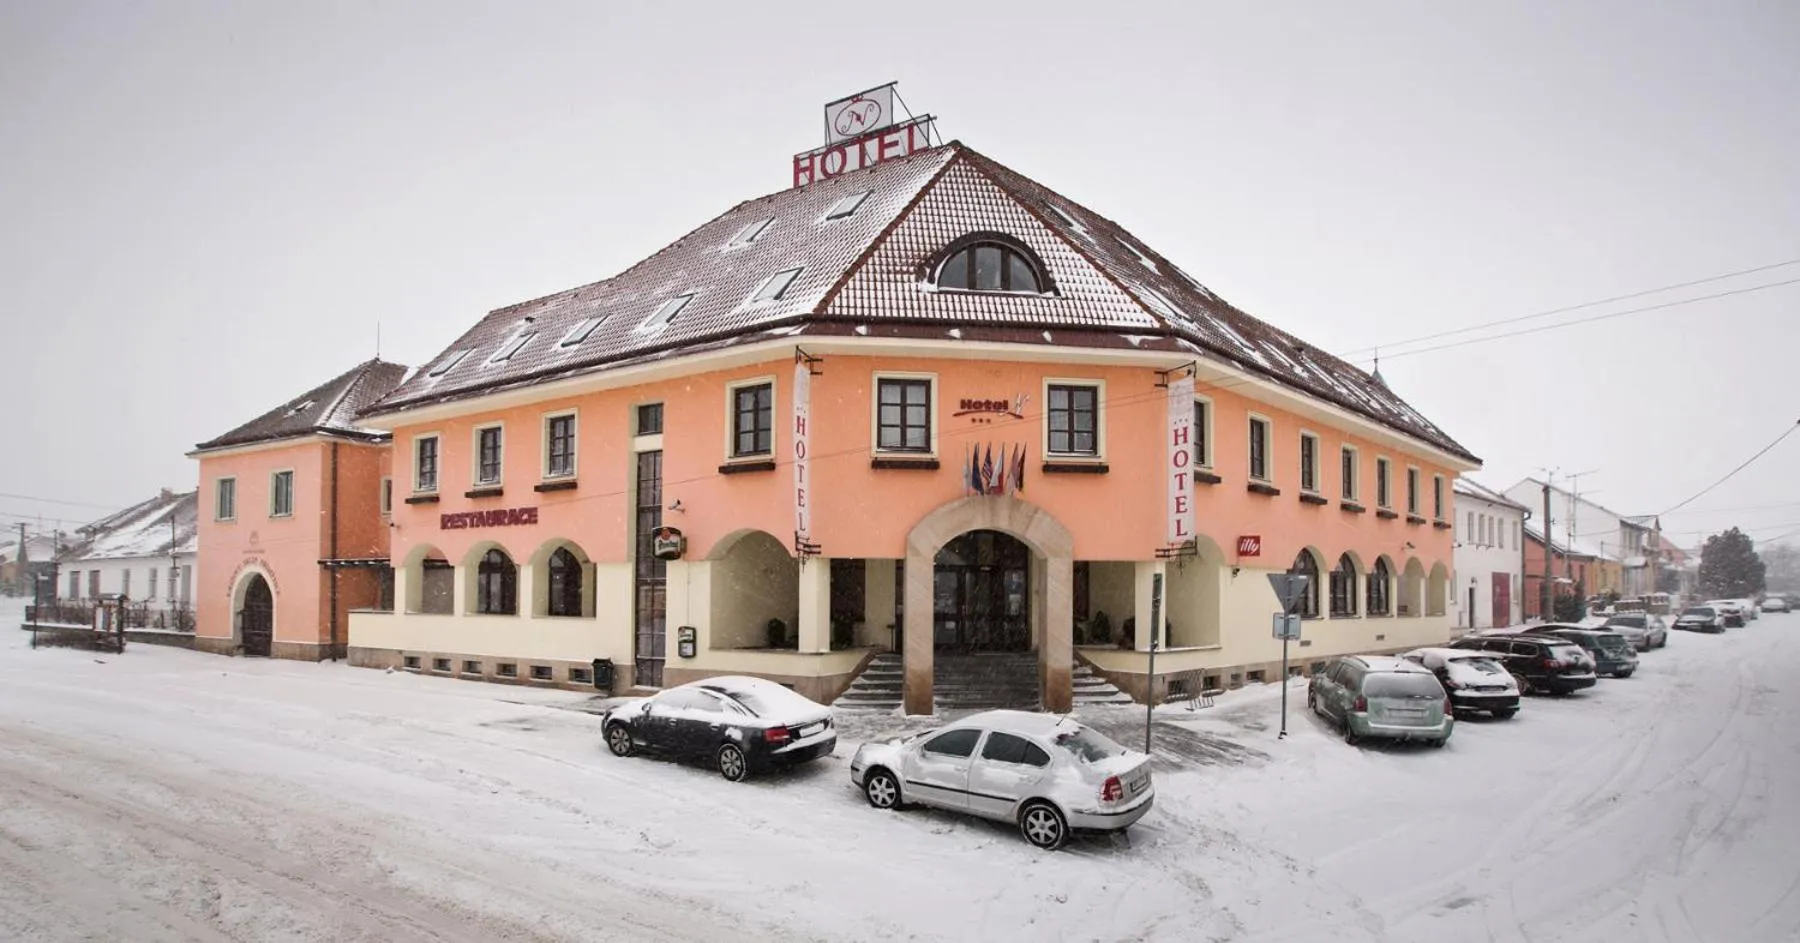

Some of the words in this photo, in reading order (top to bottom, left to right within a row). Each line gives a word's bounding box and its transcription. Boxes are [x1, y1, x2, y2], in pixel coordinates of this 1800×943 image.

[793, 123, 930, 189] HOTEL
[960, 399, 1008, 410] Hotel
[796, 415, 806, 532] HOTEL
[1173, 426, 1189, 537] HOTEL
[440, 507, 538, 530] RESTAURACE
[1240, 538, 1259, 555] illy
